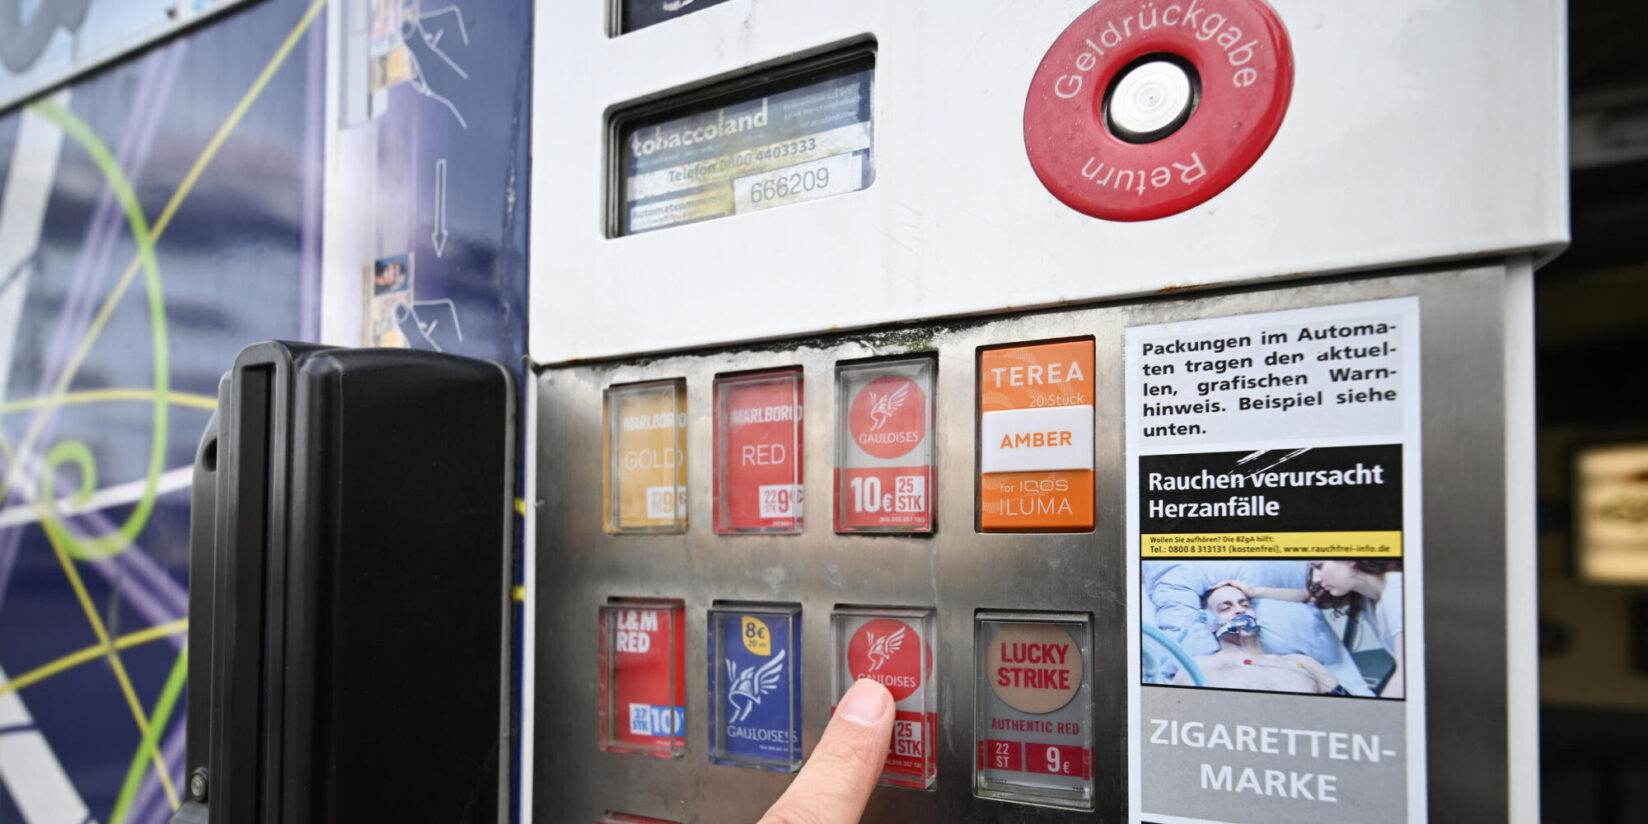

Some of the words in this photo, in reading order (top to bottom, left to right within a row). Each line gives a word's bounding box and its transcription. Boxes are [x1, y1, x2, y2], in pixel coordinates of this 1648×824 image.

[1054, 0, 1258, 99] Geldrückgabe
[632, 97, 768, 157] tobaccoland
[668, 161, 716, 183] Telefon
[719, 153, 752, 172] 0800
[755, 138, 816, 163] 4403333
[1081, 152, 1207, 196] Return
[750, 167, 829, 203] 666209
[1143, 334, 1251, 356] Packungen
[1261, 331, 1288, 346] im
[1297, 321, 1397, 342] Automa-
[1143, 362, 1174, 376] ten
[1185, 356, 1253, 374] tragen
[1264, 352, 1304, 366] den
[1316, 341, 1397, 362] aktuel-
[991, 361, 1085, 387] TEREA
[1143, 383, 1178, 397] len,
[1197, 373, 1308, 396] grafischen
[1329, 365, 1397, 383] Warn-
[1029, 394, 1045, 408] 20
[1143, 401, 1227, 417] hinweis.
[1239, 391, 1322, 411] Beispiel
[1336, 387, 1397, 405] siehe
[859, 431, 919, 445] GAULOISES
[1000, 431, 1072, 449] AMBER
[1143, 422, 1207, 437] unten.
[624, 447, 685, 471] GOLD
[742, 444, 786, 466] RED
[897, 478, 914, 494] 25
[1000, 481, 1015, 493] for
[1020, 479, 1069, 496] IQOS
[1149, 469, 1245, 491] Rauchen
[1250, 463, 1384, 488] verursacht
[764, 489, 777, 503] 22
[897, 495, 921, 512] STK
[1000, 497, 1073, 516] ILUMA
[1149, 495, 1280, 518] Herzanfälle
[1150, 545, 1167, 553] Tel.:
[1168, 545, 1188, 553] 0800
[1190, 545, 1196, 553] 8
[1197, 545, 1226, 553] 313131
[1283, 544, 1391, 553] www.rauchfrei-info.de
[617, 610, 658, 631] L&M
[745, 622, 765, 639] 8€
[616, 632, 650, 653] RED
[1000, 642, 1069, 665] LUCKY
[997, 667, 1071, 690] STRIKE
[633, 707, 648, 719] 27
[727, 724, 798, 744] GAULOISES
[897, 721, 912, 738] 25
[991, 718, 1053, 734] AUTHENTIC
[1057, 720, 1080, 736] RED
[897, 738, 921, 756] STK
[995, 742, 1009, 755] 22
[1149, 718, 1397, 763] ZIGARETTEN-
[996, 756, 1009, 769] ST
[1200, 763, 1338, 803] MARKE
